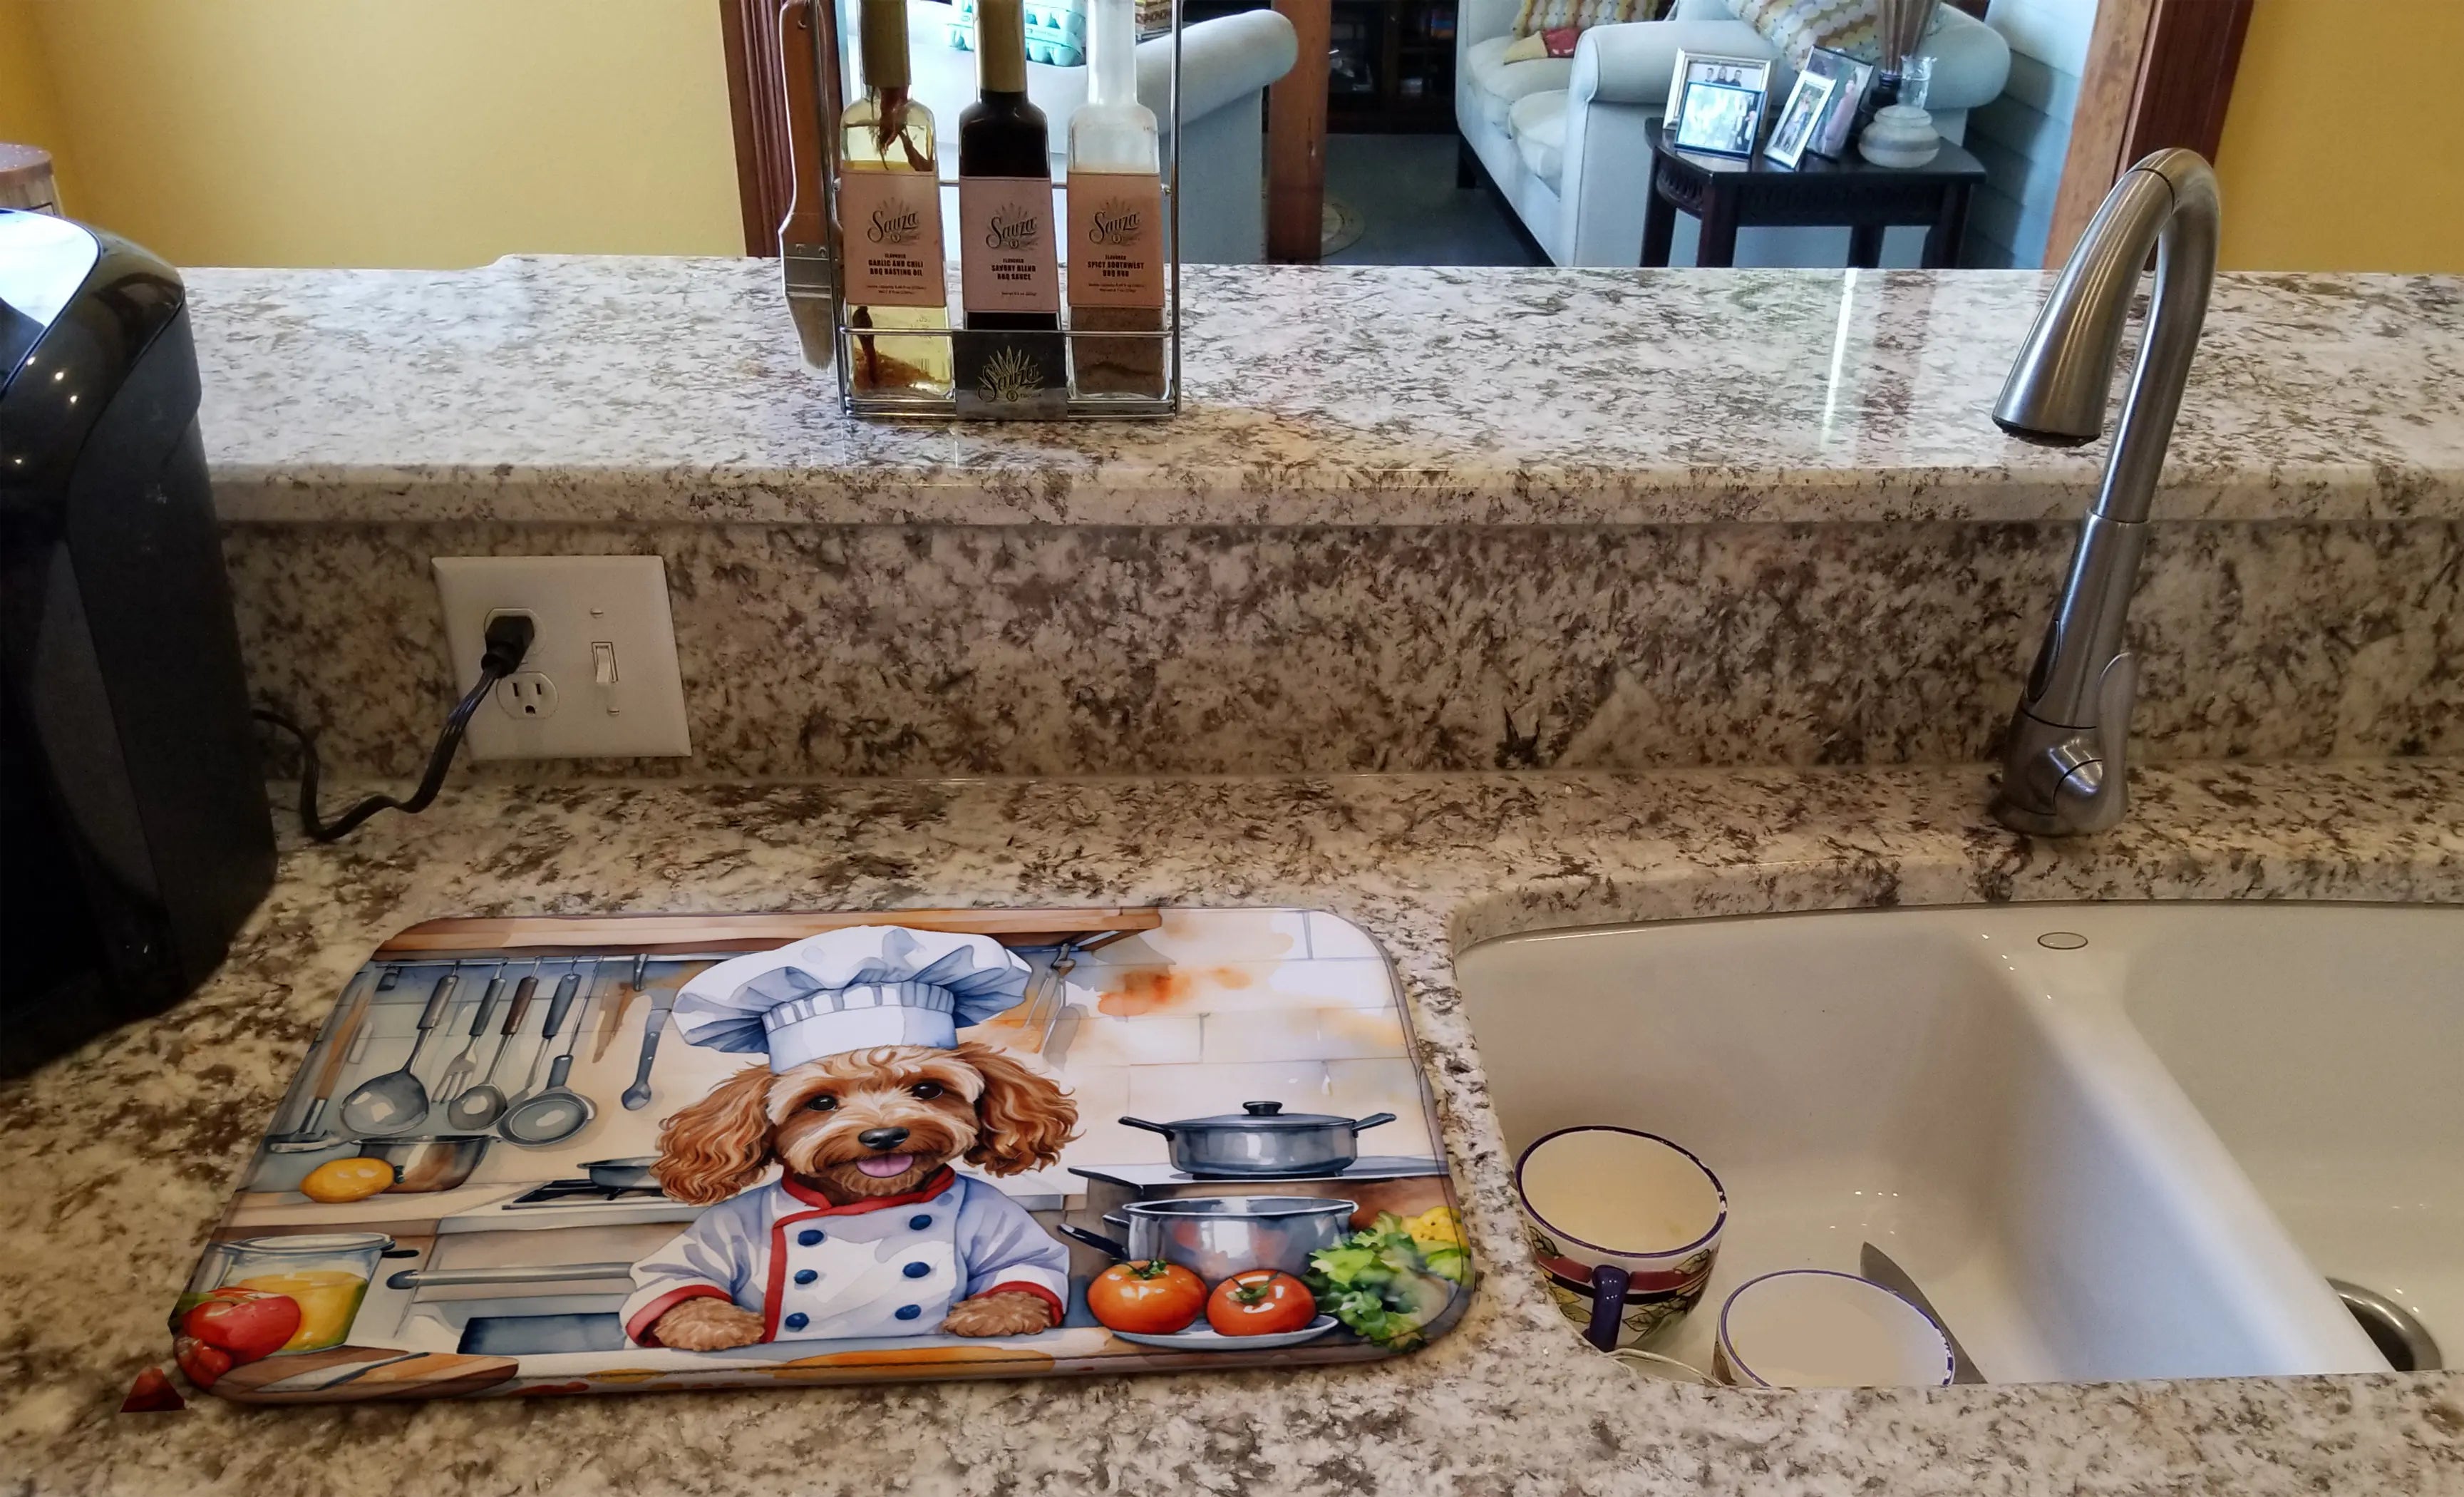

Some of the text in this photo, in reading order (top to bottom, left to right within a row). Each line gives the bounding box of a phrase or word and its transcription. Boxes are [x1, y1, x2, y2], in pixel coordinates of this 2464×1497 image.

[867, 210, 919, 243] Sauza
[986, 216, 1037, 249] Sauza
[1089, 212, 1140, 245] Sauza
[978, 363, 1043, 402] Sauza
